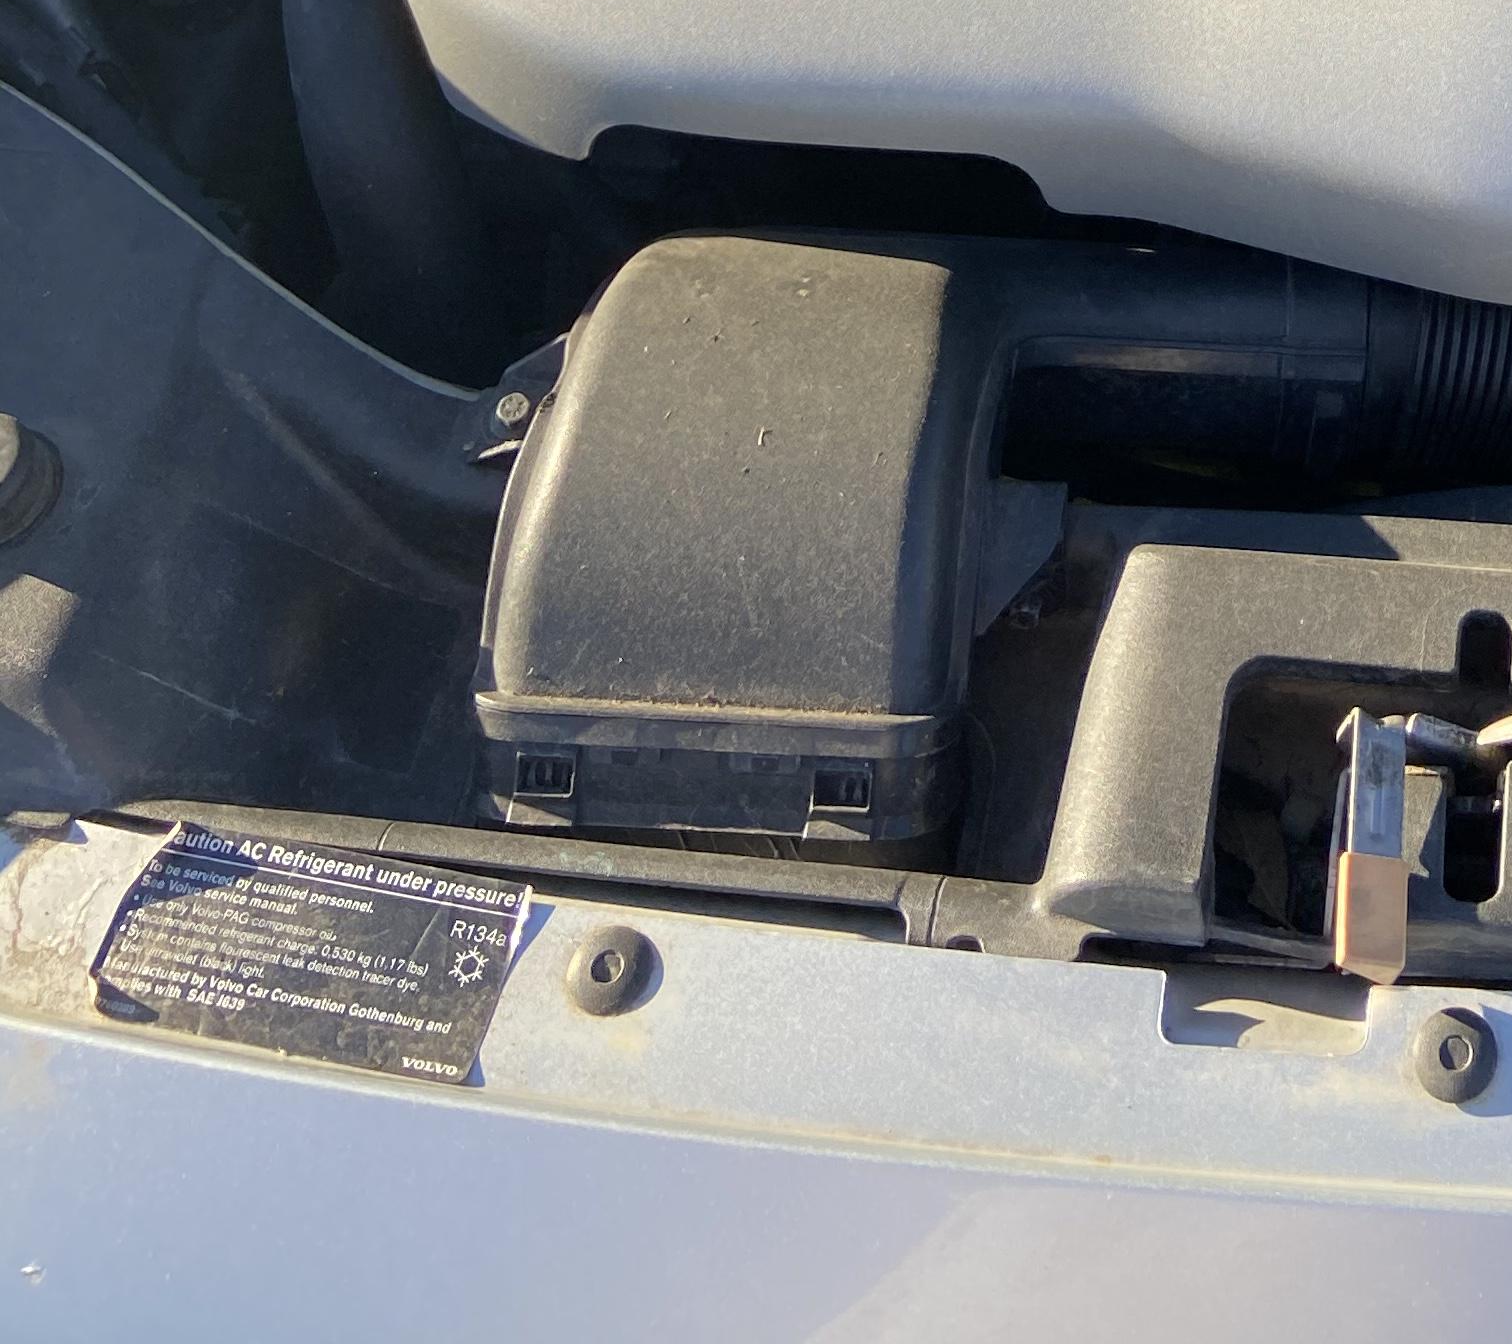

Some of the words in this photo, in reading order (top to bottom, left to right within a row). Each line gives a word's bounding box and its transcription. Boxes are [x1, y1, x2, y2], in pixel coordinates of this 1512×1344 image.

[148, 859, 163, 873] To
[165, 864, 181, 876] be
[183, 867, 235, 886] serviced
[236, 877, 253, 891] by
[253, 880, 307, 900] qualified
[308, 892, 375, 914] personnel.
[173, 829, 234, 854] aution
[236, 839, 267, 861] AC
[268, 845, 374, 880] Refrigerant
[377, 868, 433, 892] under
[435, 879, 524, 910] pressure!
[141, 874, 165, 889] See
[168, 879, 202, 897] Volvo
[204, 888, 248, 905] service
[249, 897, 298, 915] manual.
[134, 908, 217, 936] Recommended
[218, 927, 276, 948] refrigerant
[321, 944, 355, 962] 0,530
[357, 952, 372, 969] kg
[165, 901, 189, 916] only
[192, 903, 250, 924] Volvo-PAG
[251, 917, 318, 939] compressor
[450, 920, 508, 948] R134a
[170, 935, 217, 953] contains
[282, 954, 305, 969] leak
[307, 959, 359, 980] detection
[362, 969, 396, 987] tracer
[396, 977, 421, 994] dye.
[154, 984, 182, 999] with
[186, 989, 216, 1005] SAE
[190, 972, 207, 989] by
[209, 975, 244, 994] Volvo
[246, 983, 270, 999] Car
[271, 988, 346, 1014] Corporation
[349, 1003, 425, 1032] Gothenburg
[426, 1019, 452, 1034] and
[401, 1056, 458, 1075] VOLVO
